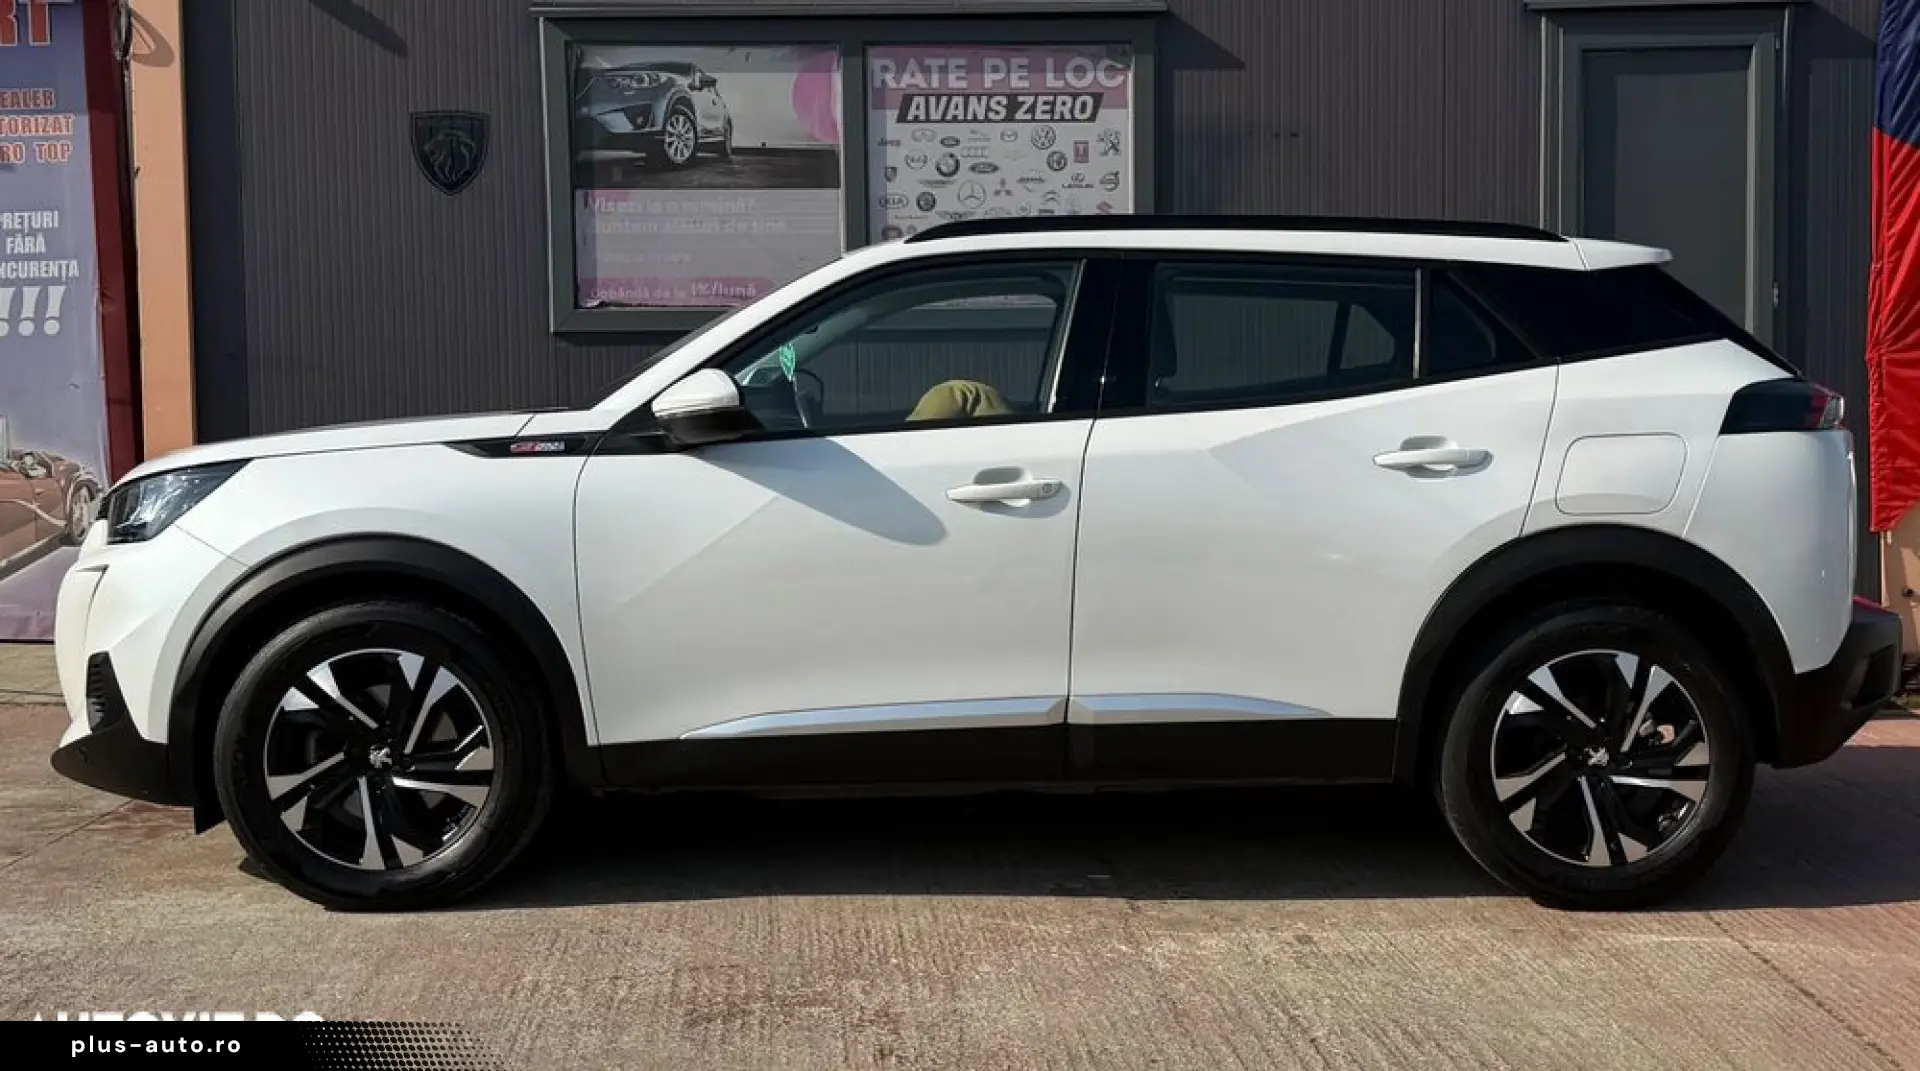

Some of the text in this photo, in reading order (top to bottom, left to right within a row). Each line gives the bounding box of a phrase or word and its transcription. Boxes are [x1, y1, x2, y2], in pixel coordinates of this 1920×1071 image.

[872, 56, 1125, 89] RATE PE LOC
[906, 95, 1094, 121] AVANS ZERO
[33, 140, 72, 164] TOP
[0, 210, 59, 233] REȚURI
